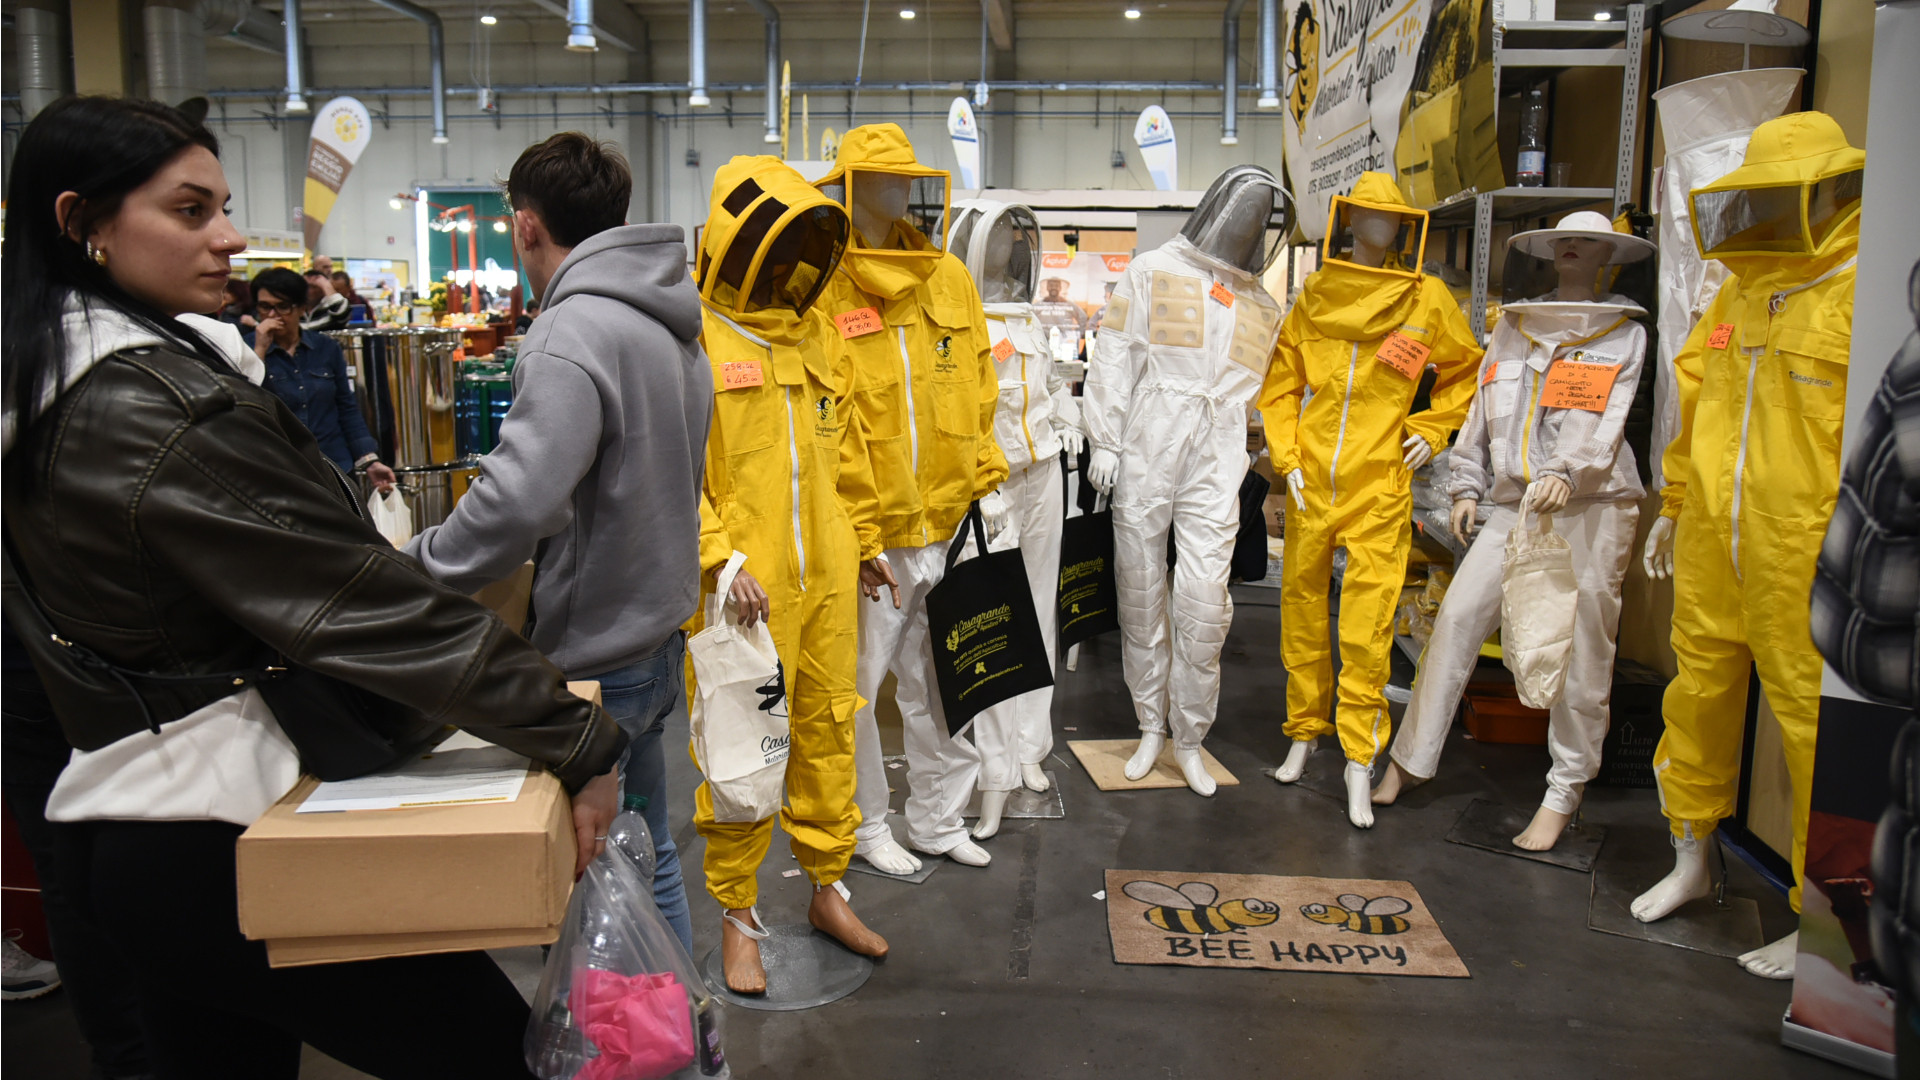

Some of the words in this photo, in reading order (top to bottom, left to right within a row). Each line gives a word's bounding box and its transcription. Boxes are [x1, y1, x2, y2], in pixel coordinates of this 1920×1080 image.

[1313, 63, 1354, 119] Materiale
[1789, 371, 1833, 388] Casagrande
[958, 603, 1011, 632] Casagrande
[1164, 936, 1255, 961] BEE
[1269, 939, 1408, 967] HAPPY
